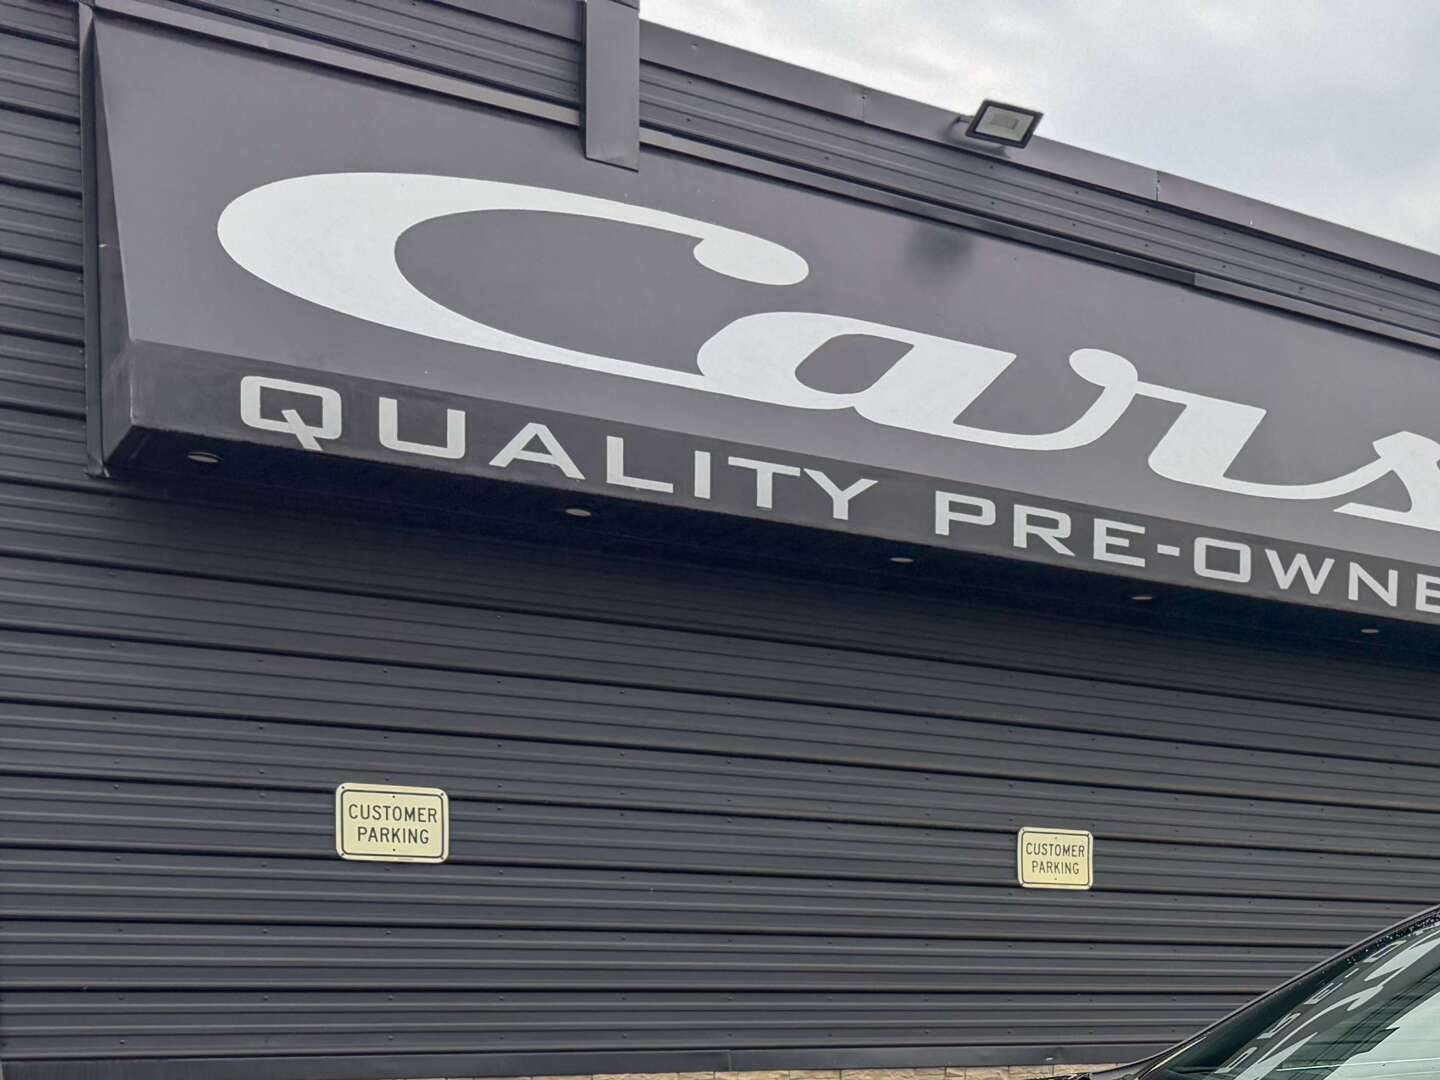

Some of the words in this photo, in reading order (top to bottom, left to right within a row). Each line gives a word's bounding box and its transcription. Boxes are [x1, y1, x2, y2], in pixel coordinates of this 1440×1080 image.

[240, 375, 878, 521] QUALITY
[348, 803, 437, 823] CUSTOMER
[357, 826, 430, 845] PARKING
[1025, 842, 1085, 858] CUSTOMER
[1031, 860, 1080, 875] PARKING
